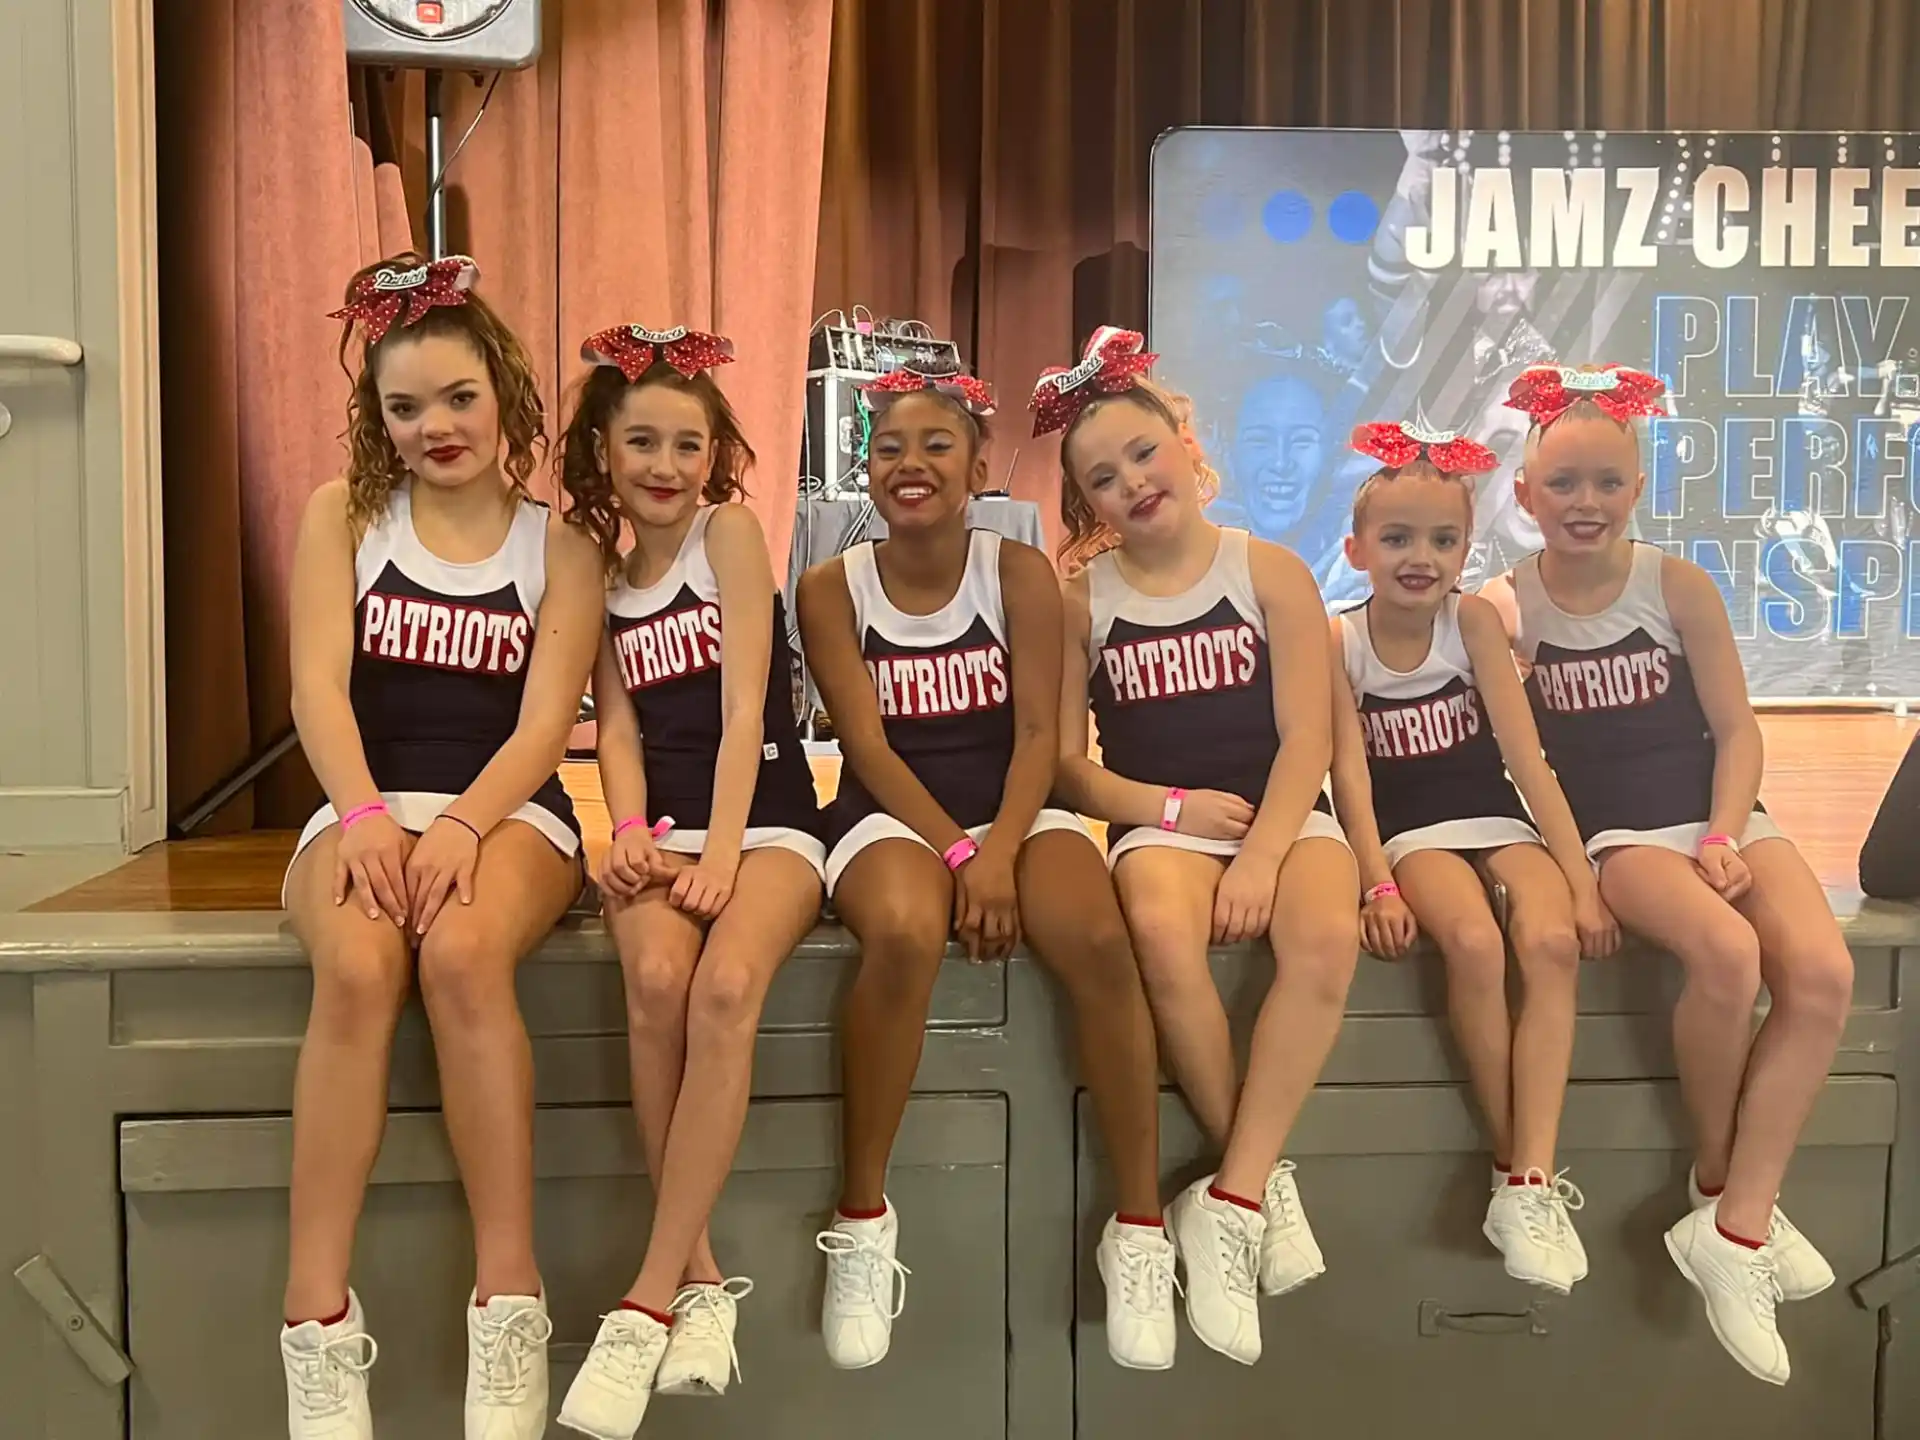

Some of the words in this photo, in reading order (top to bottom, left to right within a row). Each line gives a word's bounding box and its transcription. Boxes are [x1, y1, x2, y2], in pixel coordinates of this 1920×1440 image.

[1405, 167, 1659, 269] JAMZ
[1693, 165, 1920, 268] CHEE
[1655, 296, 1919, 397] PLAY.
[1653, 418, 1920, 518] PERF
[362, 594, 528, 673] PATRIOTS
[1650, 540, 1920, 640] NSP
[1102, 625, 1256, 702] PATRIOTS
[1534, 647, 1670, 711] PATRIOTS
